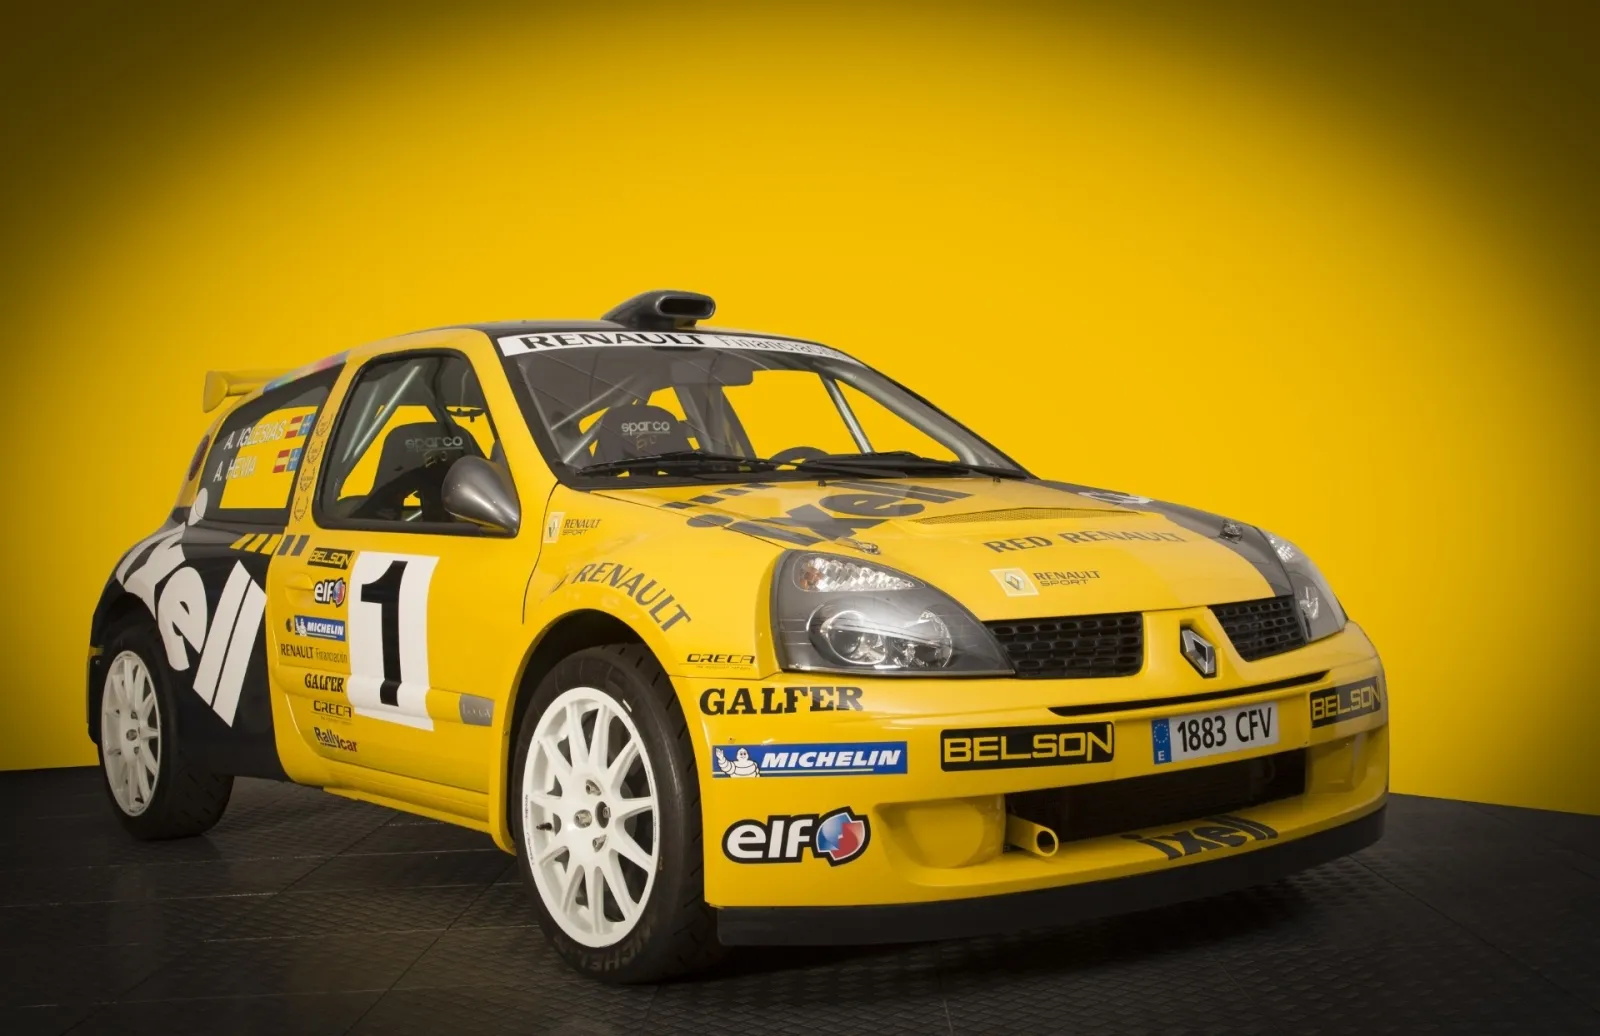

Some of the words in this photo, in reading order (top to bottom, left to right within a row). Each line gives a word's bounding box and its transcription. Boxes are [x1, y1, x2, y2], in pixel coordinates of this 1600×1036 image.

[519, 333, 705, 349] RENAULT
[224, 430, 236, 450] A.
[236, 420, 287, 448] IGLESIAS
[621, 421, 670, 441] sparco
[212, 460, 224, 482] A.
[564, 518, 602, 528] RENAULT
[686, 480, 974, 546] ixell
[983, 536, 1053, 553] RED
[1057, 530, 1187, 544] RENAULT
[310, 550, 354, 568] BELSON
[1033, 571, 1100, 581] RENAULT
[1040, 579, 1089, 587] SPORT
[314, 580, 335, 603] elf
[571, 562, 691, 632] RENAULT
[115, 487, 268, 728] ixell
[306, 621, 344, 636] MICHELIN
[361, 560, 408, 707] 1
[280, 643, 314, 659] RENAULT
[687, 653, 755, 664] ORECA
[304, 673, 345, 693] GALFER
[699, 686, 864, 715] GALFER
[1311, 678, 1381, 722] BELSON
[1177, 715, 1227, 752] 1883
[1235, 707, 1272, 742] CFV
[943, 724, 1112, 763] BELSON
[761, 749, 902, 768] MICHELIN
[1157, 750, 1165, 761] E
[726, 818, 814, 859] elf
[1120, 816, 1279, 860] ixell
